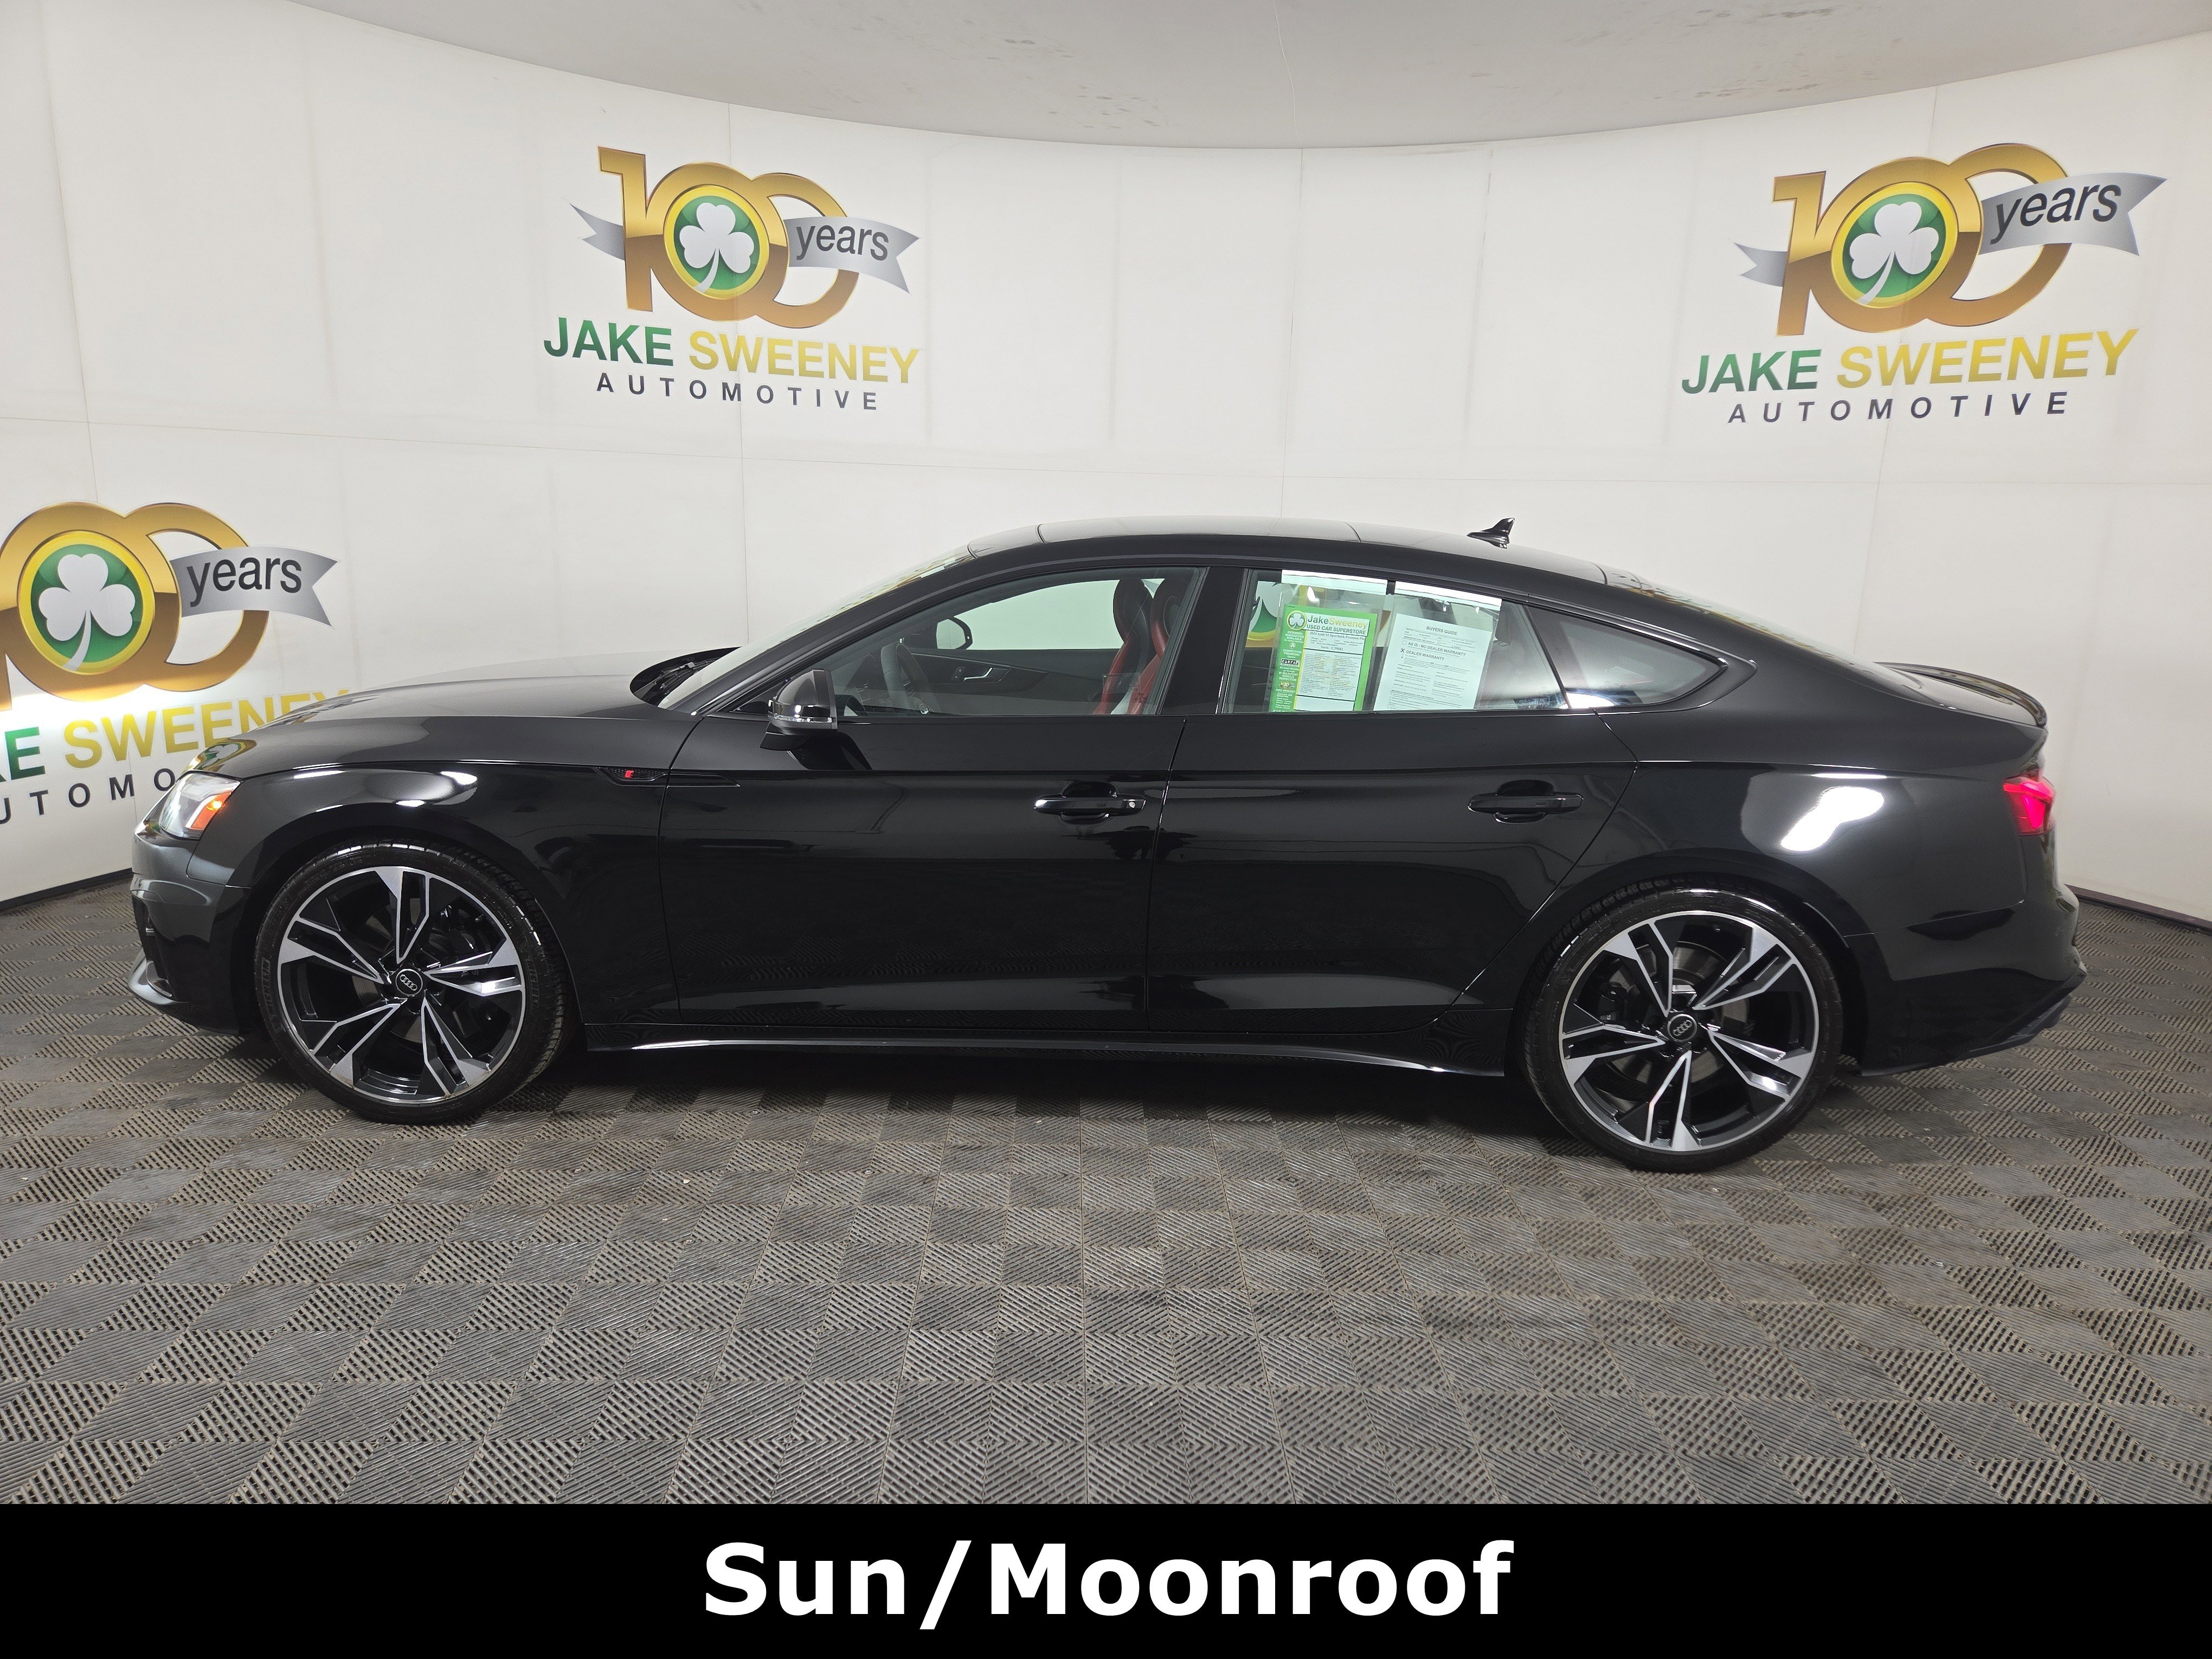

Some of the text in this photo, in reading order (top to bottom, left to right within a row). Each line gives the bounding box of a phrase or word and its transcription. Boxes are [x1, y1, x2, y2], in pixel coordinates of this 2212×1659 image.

[796, 224, 889, 261] years
[1990, 183, 2122, 245] years
[544, 317, 921, 384] JAKE SWEENEY
[1682, 328, 2139, 394] JAKE SWEENEY
[596, 372, 877, 410] AUTOMOTIVE
[1728, 391, 2068, 424] AUTOMOTIVE
[0, 501, 302, 711] 00 years
[63, 690, 350, 768] SWEEN
